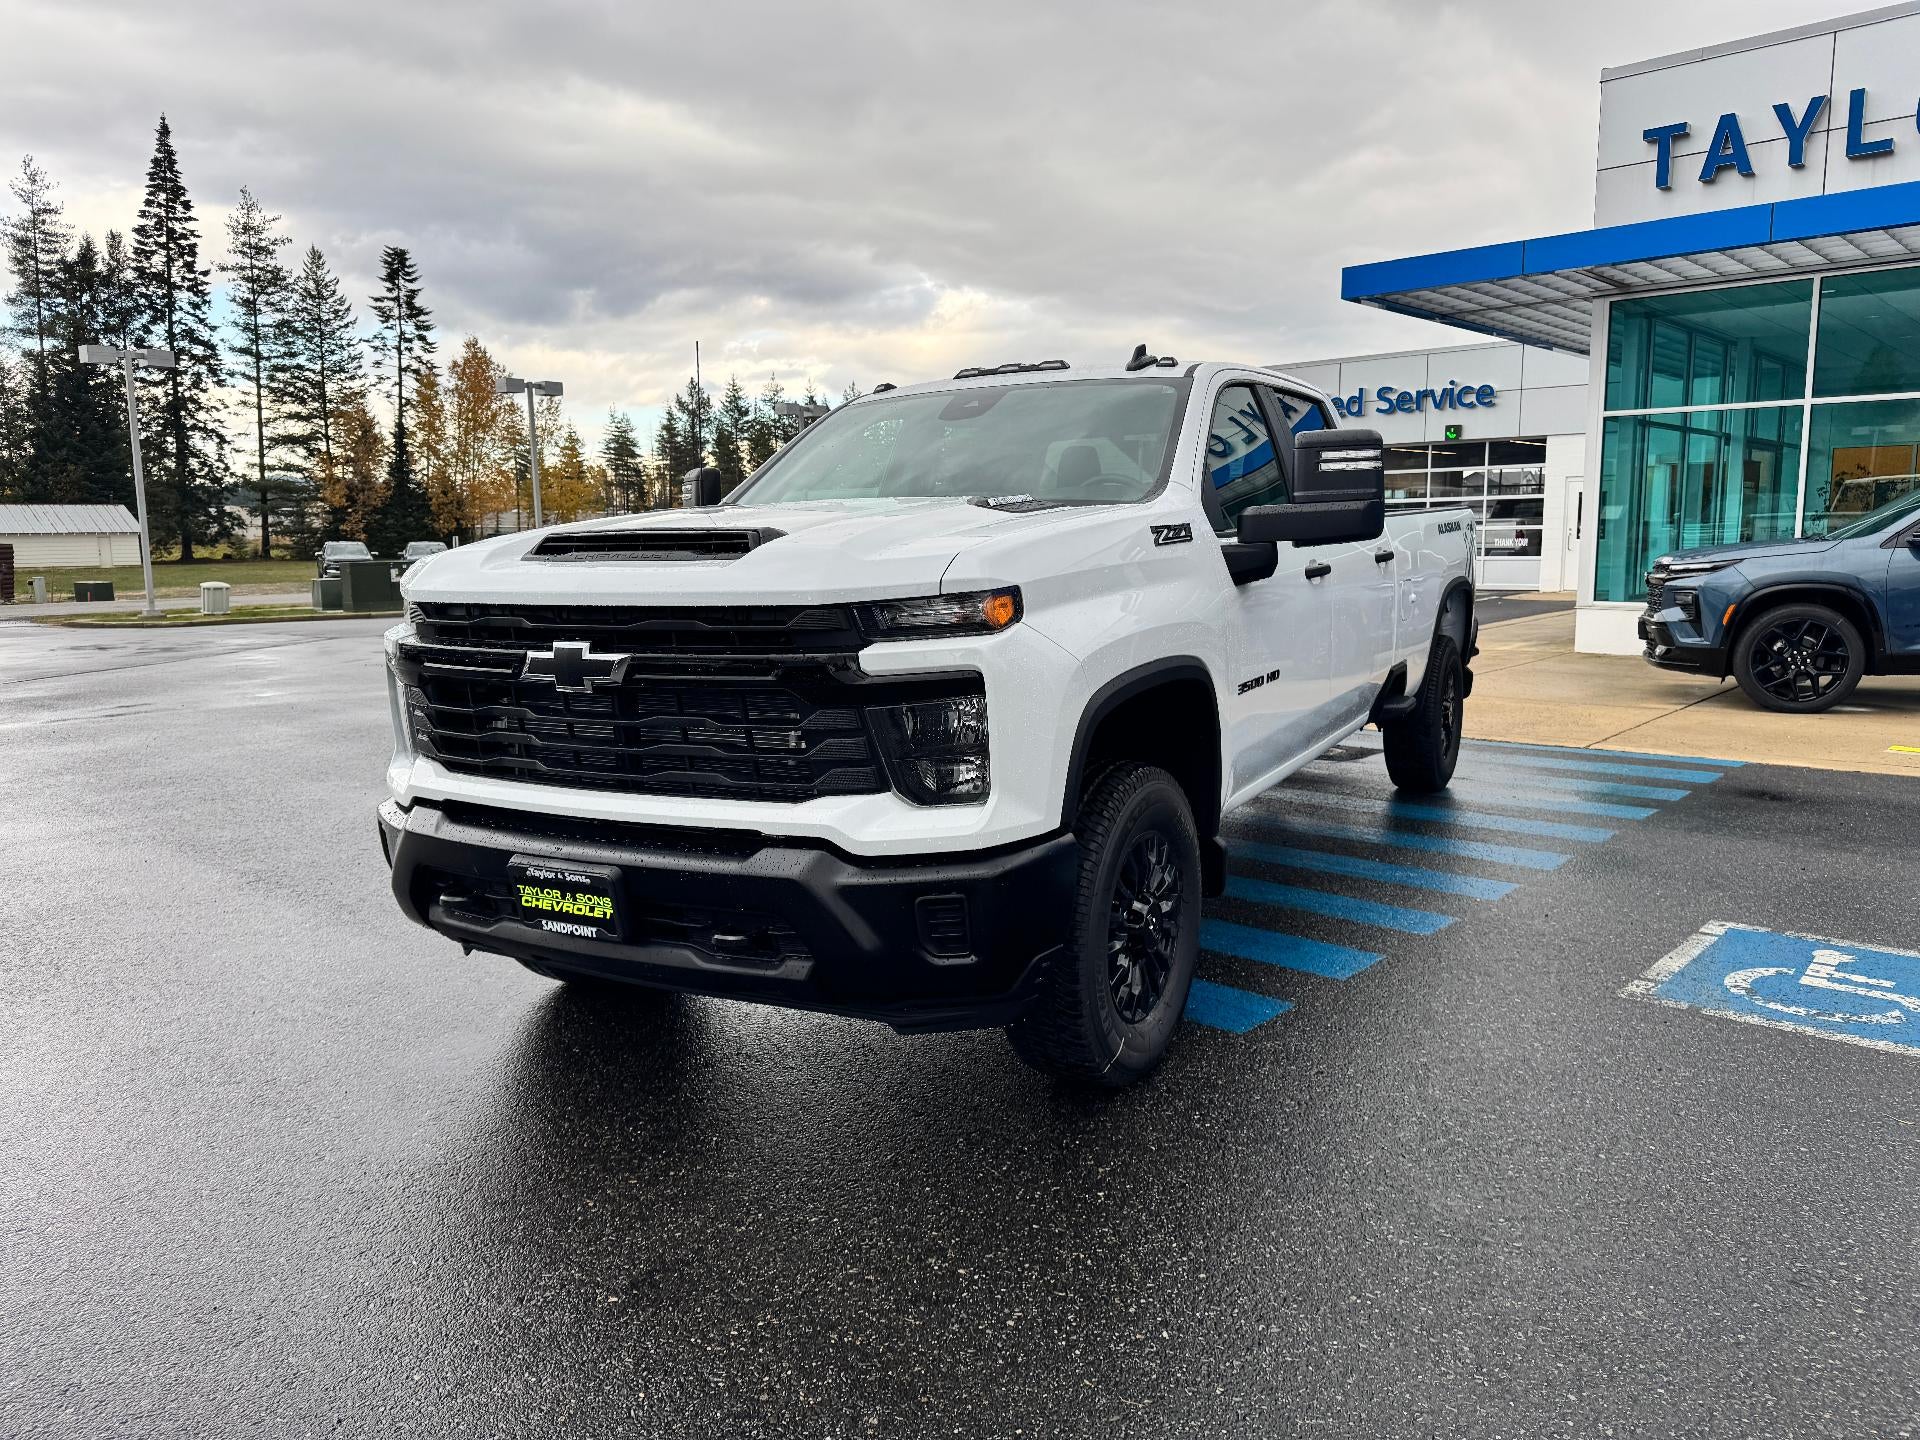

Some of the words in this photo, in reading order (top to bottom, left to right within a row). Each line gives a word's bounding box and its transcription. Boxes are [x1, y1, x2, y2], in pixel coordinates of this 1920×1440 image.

[1643, 87, 1920, 190] TAYL
[1331, 387, 1366, 417] ed
[1376, 379, 1496, 414] Service
[1150, 523, 1193, 547] Z71
[1437, 521, 1461, 535] ALASKAN
[1494, 538, 1514, 546] THANK
[1237, 675, 1264, 696] 3500
[1266, 669, 1280, 684] HD
[527, 867, 555, 880] Taylor
[517, 884, 561, 900] TAYLOR
[565, 892, 573, 903] &
[576, 893, 613, 908] SONS
[521, 896, 614, 919] CHEVROLET
[541, 919, 598, 938] SANDPOINT
